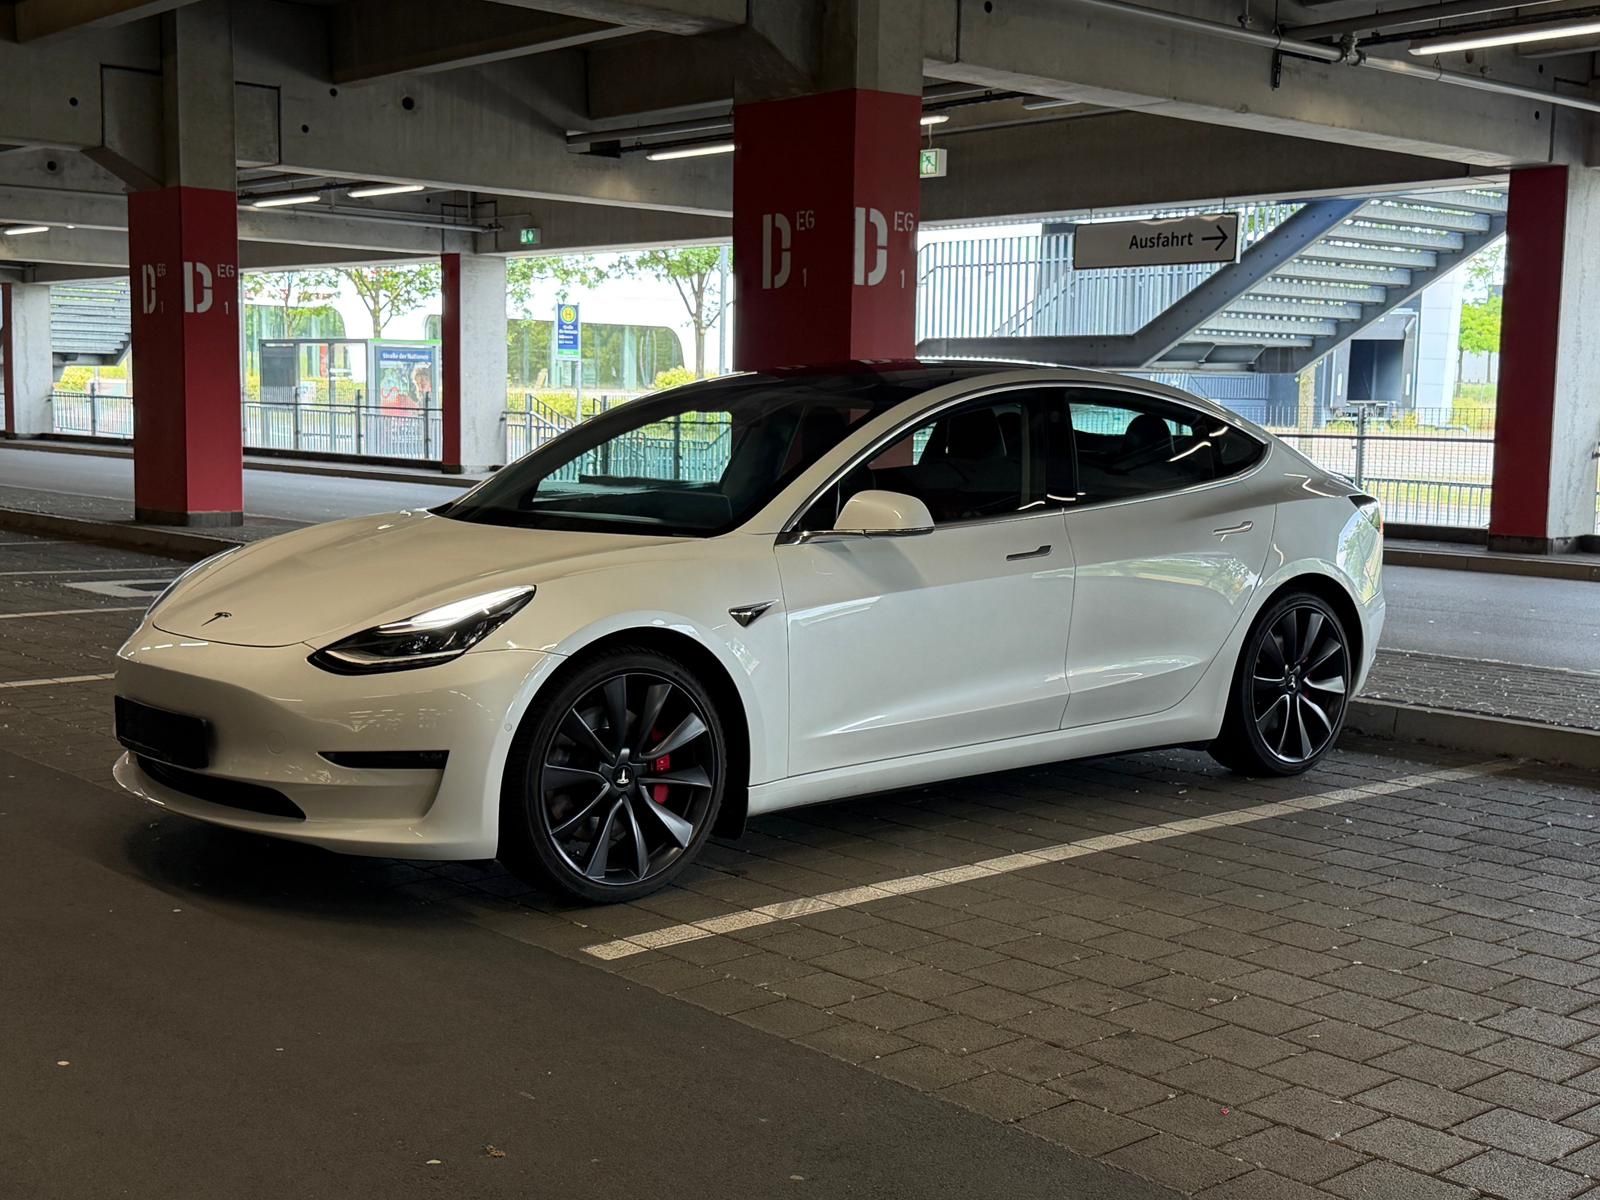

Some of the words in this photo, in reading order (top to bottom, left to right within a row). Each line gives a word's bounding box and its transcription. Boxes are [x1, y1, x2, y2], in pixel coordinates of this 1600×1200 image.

[796, 209, 815, 231] EG
[893, 210, 914, 231] EG
[762, 213, 791, 289] D
[854, 206, 888, 286] D
[1129, 232, 1193, 250] Ausfahrt
[217, 263, 235, 278] EG
[802, 268, 808, 288] 1
[900, 269, 905, 289] 1
[142, 263, 156, 314] D
[183, 261, 213, 313] D
[224, 301, 229, 315] 1
